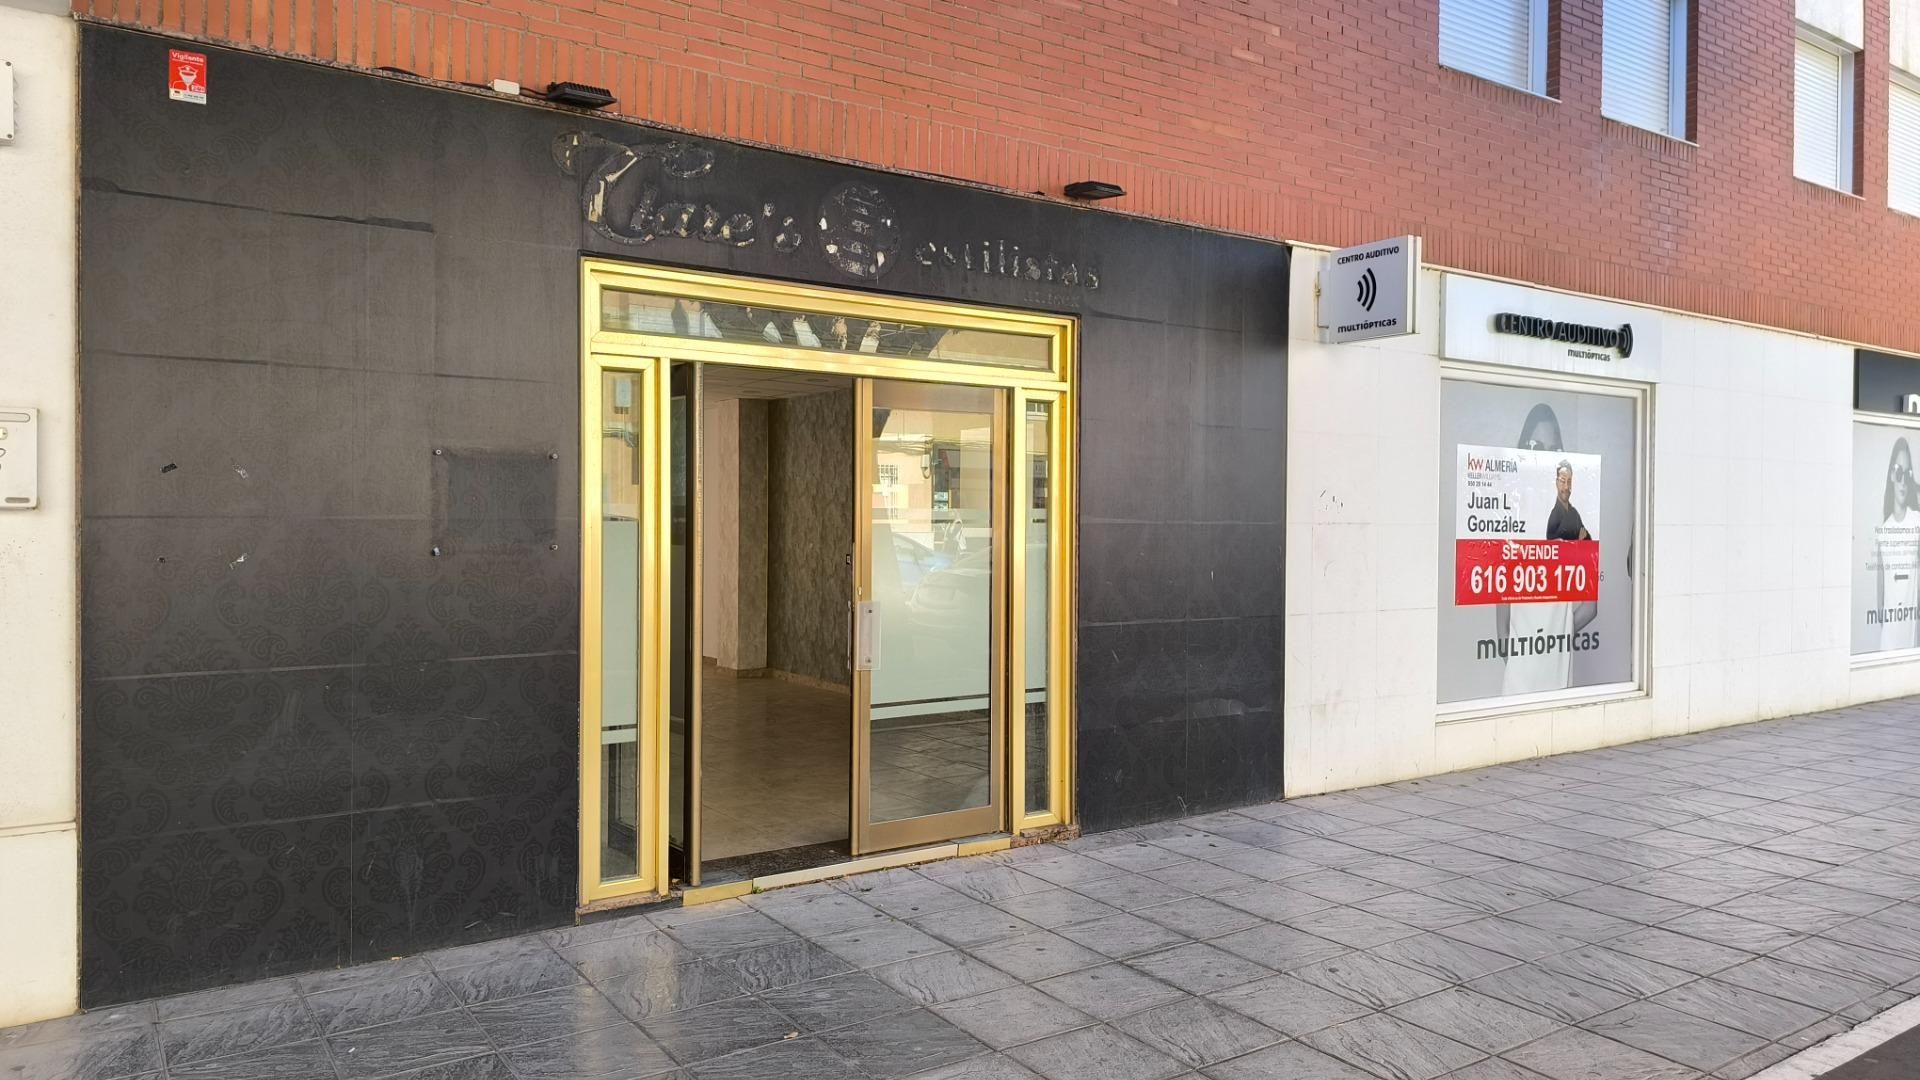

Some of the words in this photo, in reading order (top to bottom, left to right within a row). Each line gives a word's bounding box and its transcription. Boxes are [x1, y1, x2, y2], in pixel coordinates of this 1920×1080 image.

[171, 51, 204, 63] Vigilante
[1337, 253, 1364, 265] CENTRO
[1365, 246, 1400, 259] AUDITIVO
[1496, 313, 1555, 339] CENTRO
[1556, 322, 1619, 348] AUDITIVO
[1467, 491, 1499, 509] Juan
[1503, 493, 1511, 510] L
[1467, 515, 1526, 533] González
[1502, 544, 1518, 560] SE
[1519, 544, 1559, 560] VENDE
[1470, 565, 1507, 594] 616
[1513, 565, 1548, 593] 903
[1554, 564, 1586, 592] 170
